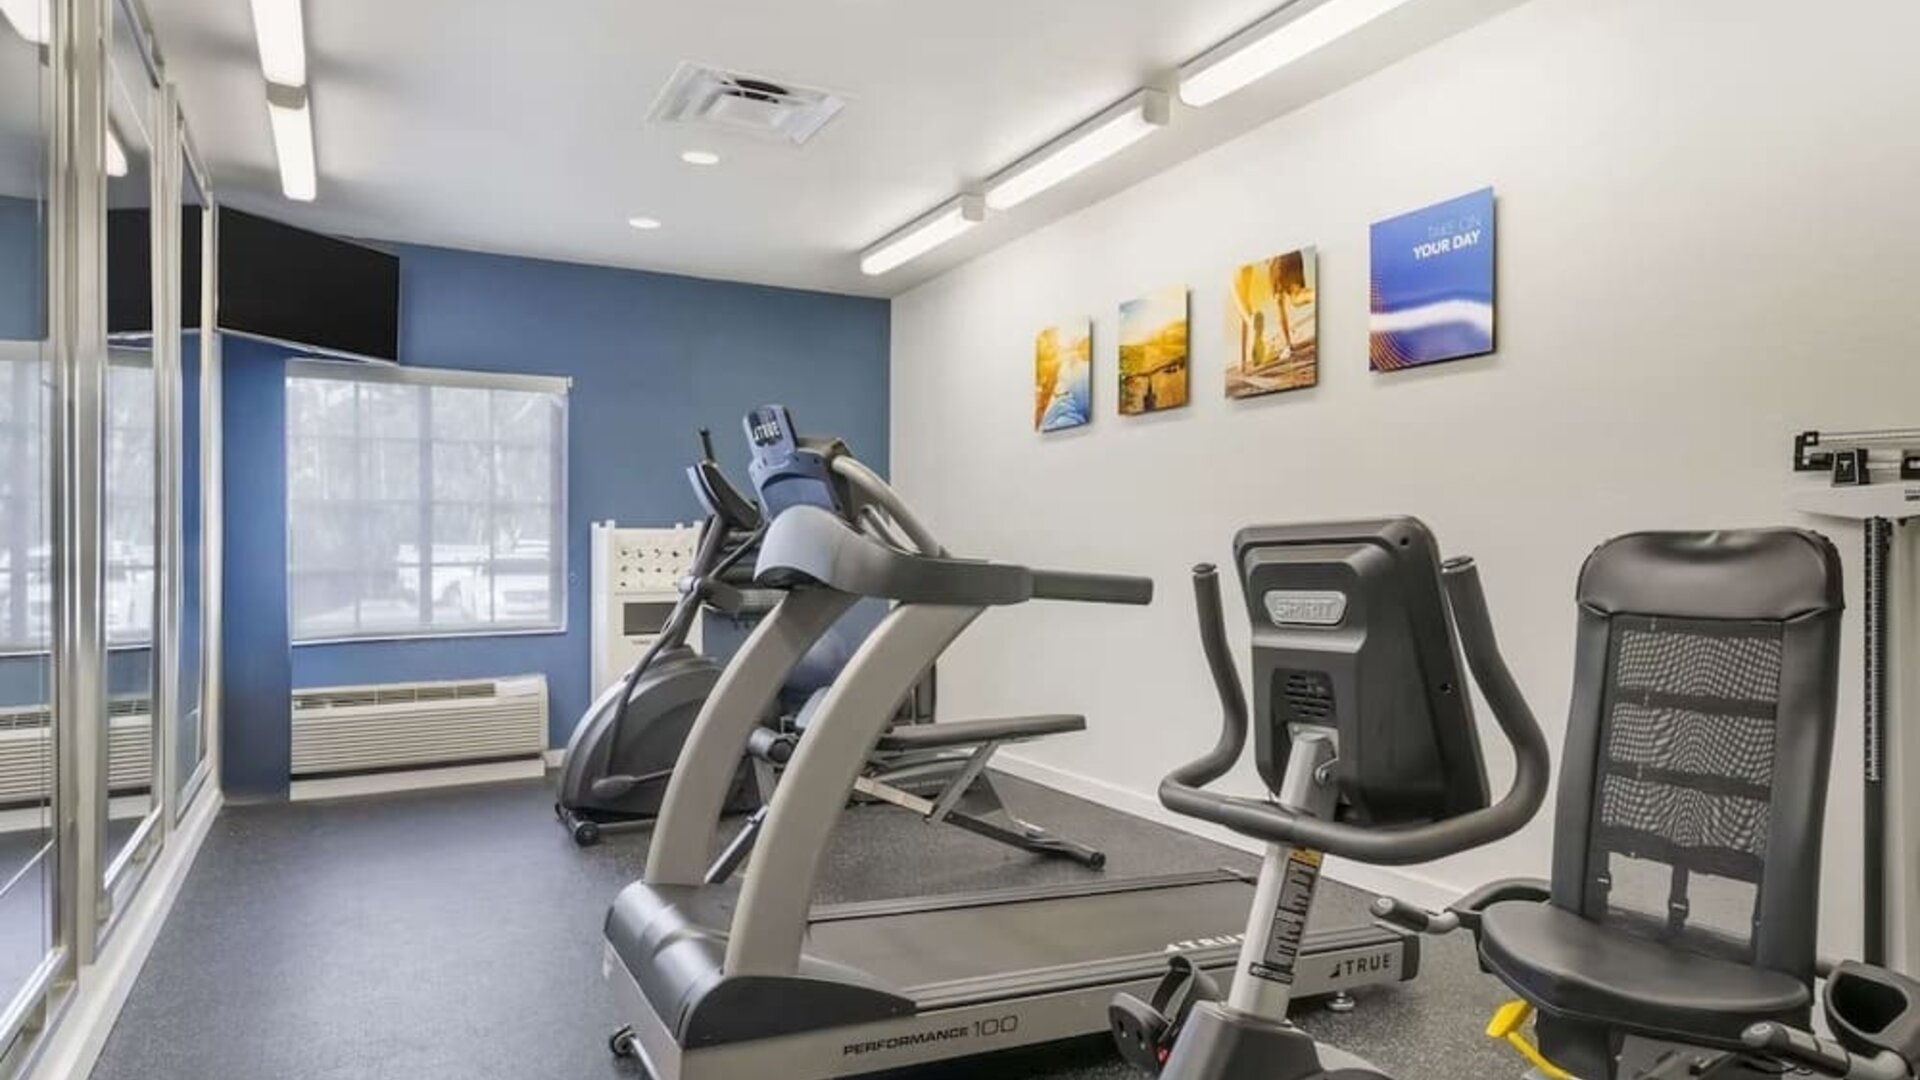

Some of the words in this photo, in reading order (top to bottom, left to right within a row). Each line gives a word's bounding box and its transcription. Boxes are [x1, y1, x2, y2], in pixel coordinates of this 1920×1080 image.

[1414, 240, 1451, 260] YOUR
[1453, 230, 1481, 249] DAY
[1275, 599, 1338, 619] SPIRIT
[1344, 953, 1392, 976] TRUE
[843, 1026, 969, 1056] PERFORMANCE
[973, 1014, 1019, 1038] 100
